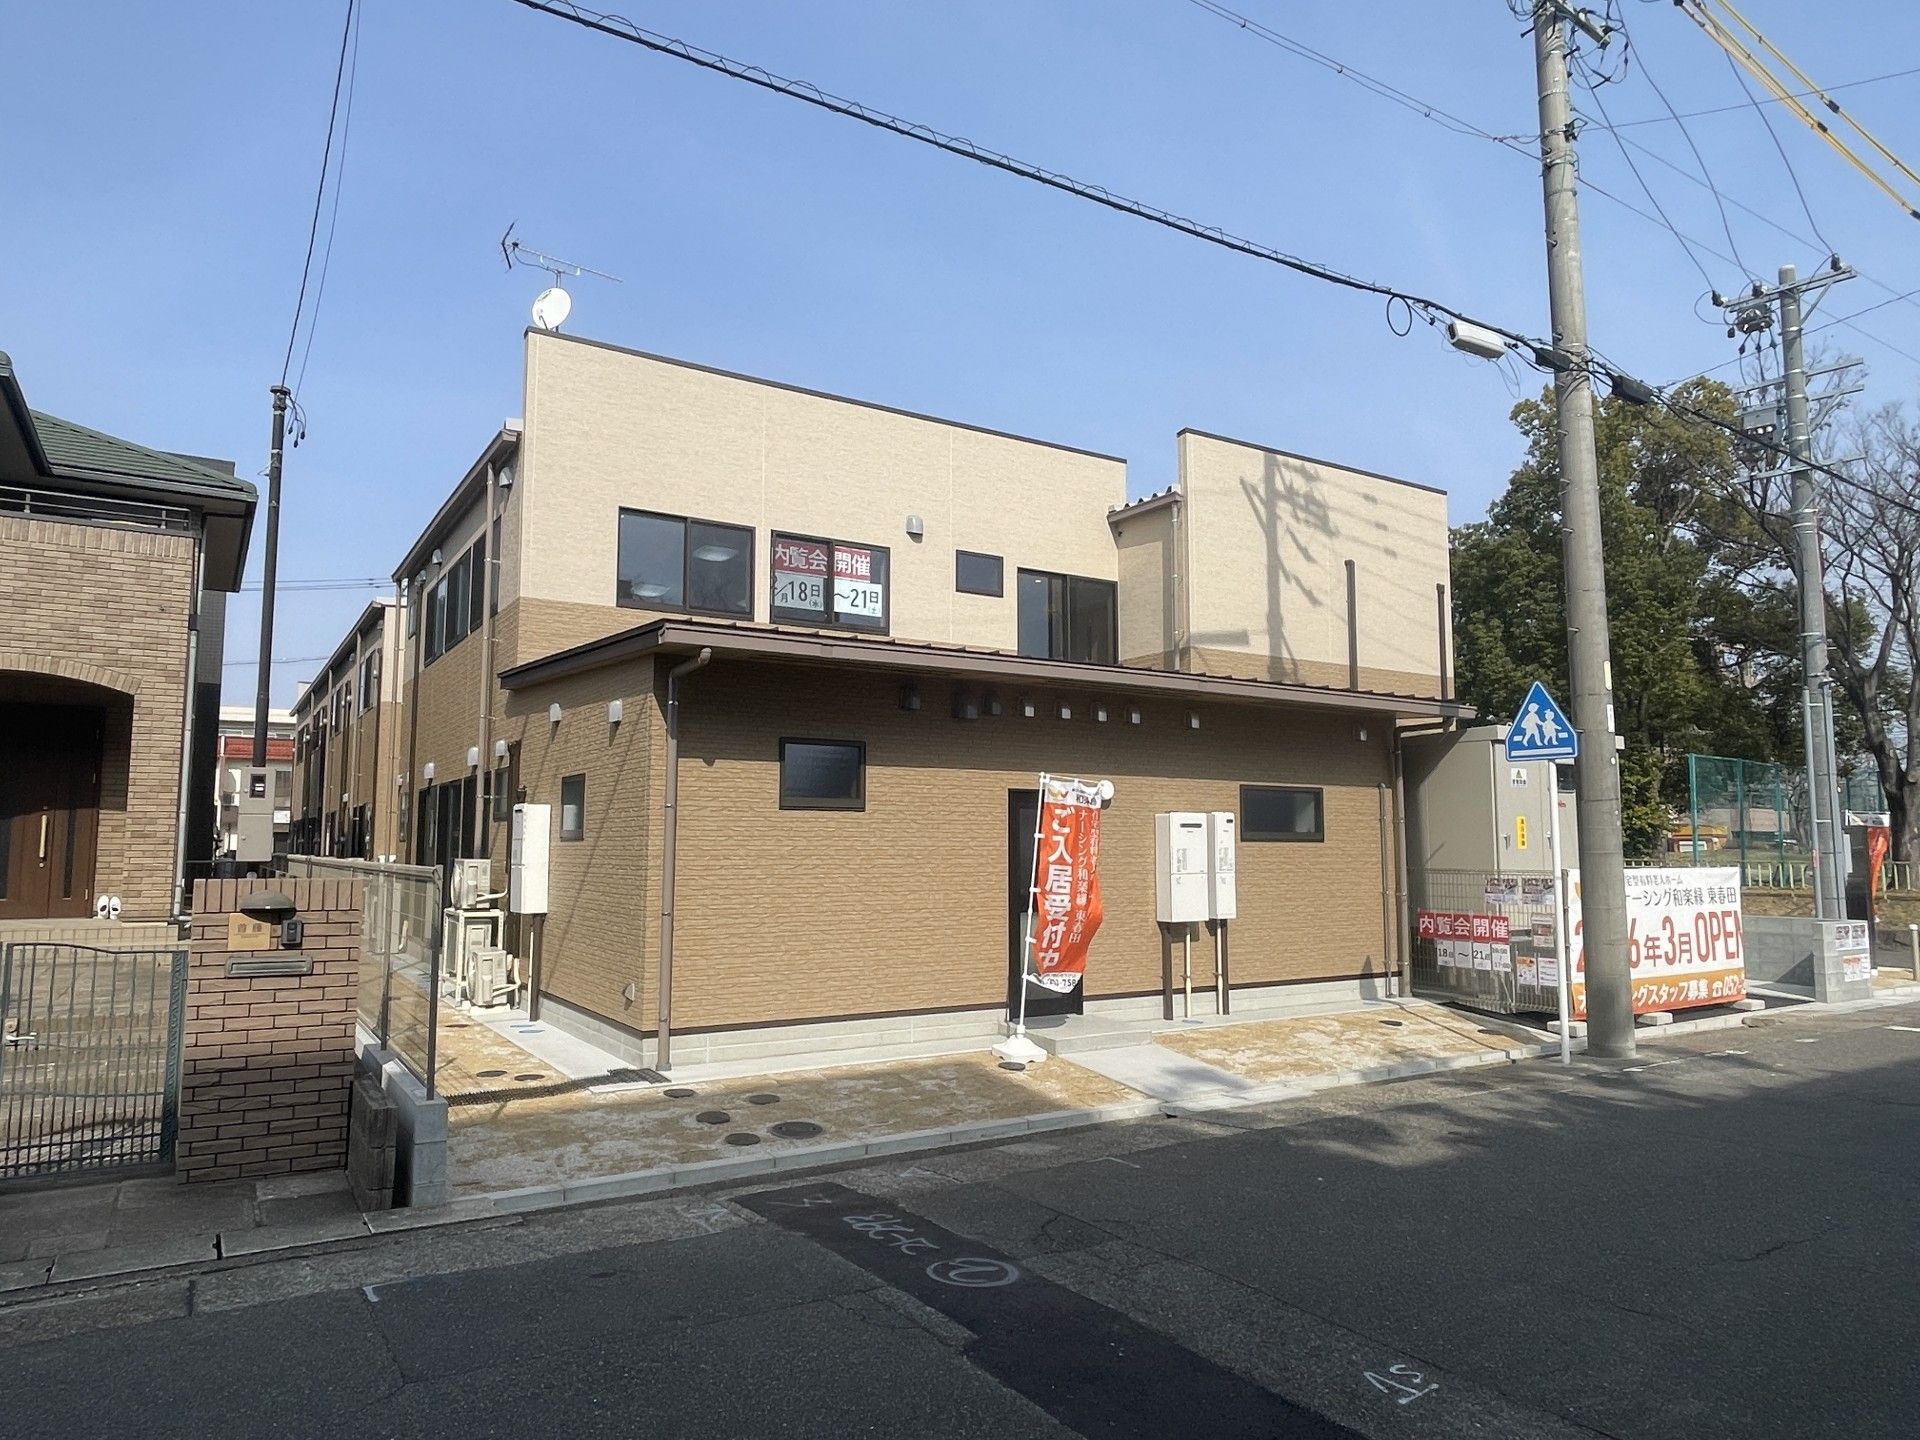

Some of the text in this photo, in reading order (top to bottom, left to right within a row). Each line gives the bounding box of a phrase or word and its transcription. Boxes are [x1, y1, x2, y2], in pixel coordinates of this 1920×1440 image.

[1707, 886, 1737, 905] 東春田
[1419, 915, 1509, 939] 内覧会開催
